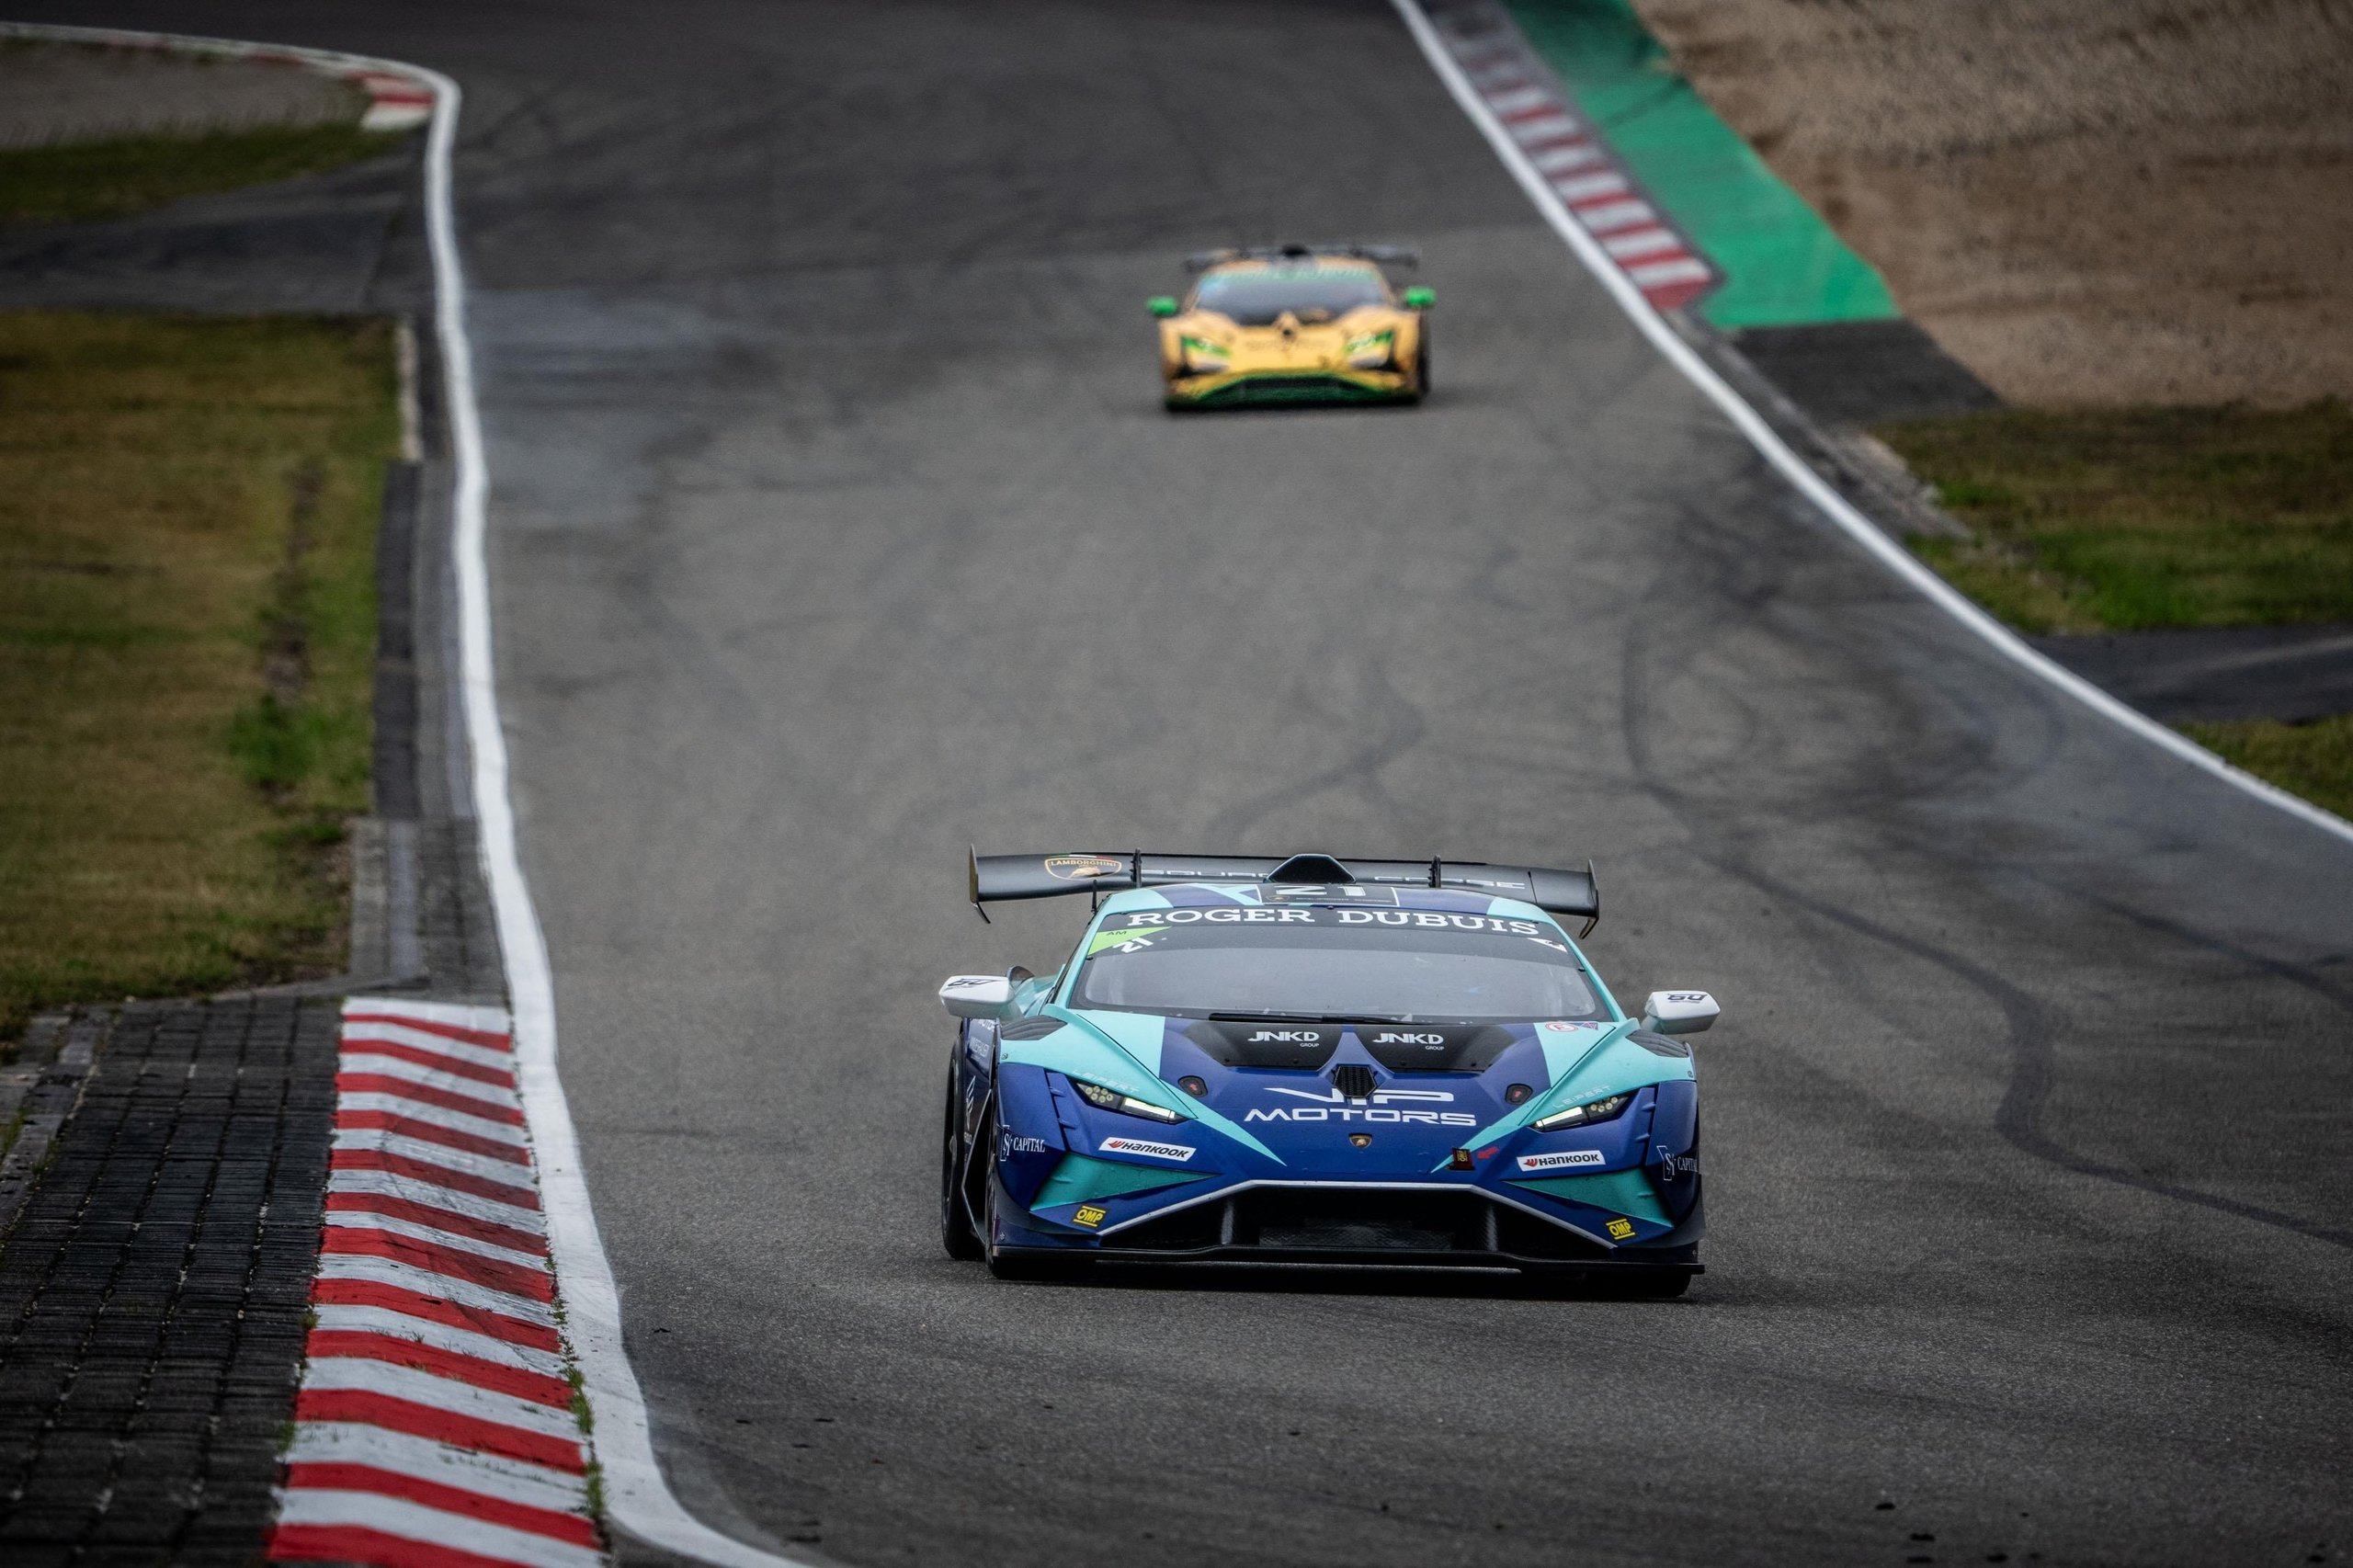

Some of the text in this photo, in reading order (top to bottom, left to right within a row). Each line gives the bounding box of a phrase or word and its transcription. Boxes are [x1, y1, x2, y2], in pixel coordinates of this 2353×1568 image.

[1051, 858, 1117, 867] LAMBORGHINI
[1127, 908, 1540, 936] ROGER DUBUIS
[1112, 937, 1154, 954] 21
[1247, 1030, 1320, 1043] JNKD
[1372, 1032, 1445, 1045] JNKD
[1243, 1108, 1477, 1127] MOTORS
[1013, 1137, 1046, 1153] CAPITAL
[1075, 1209, 1103, 1223] OMP
[1608, 1221, 1631, 1236] OMP
